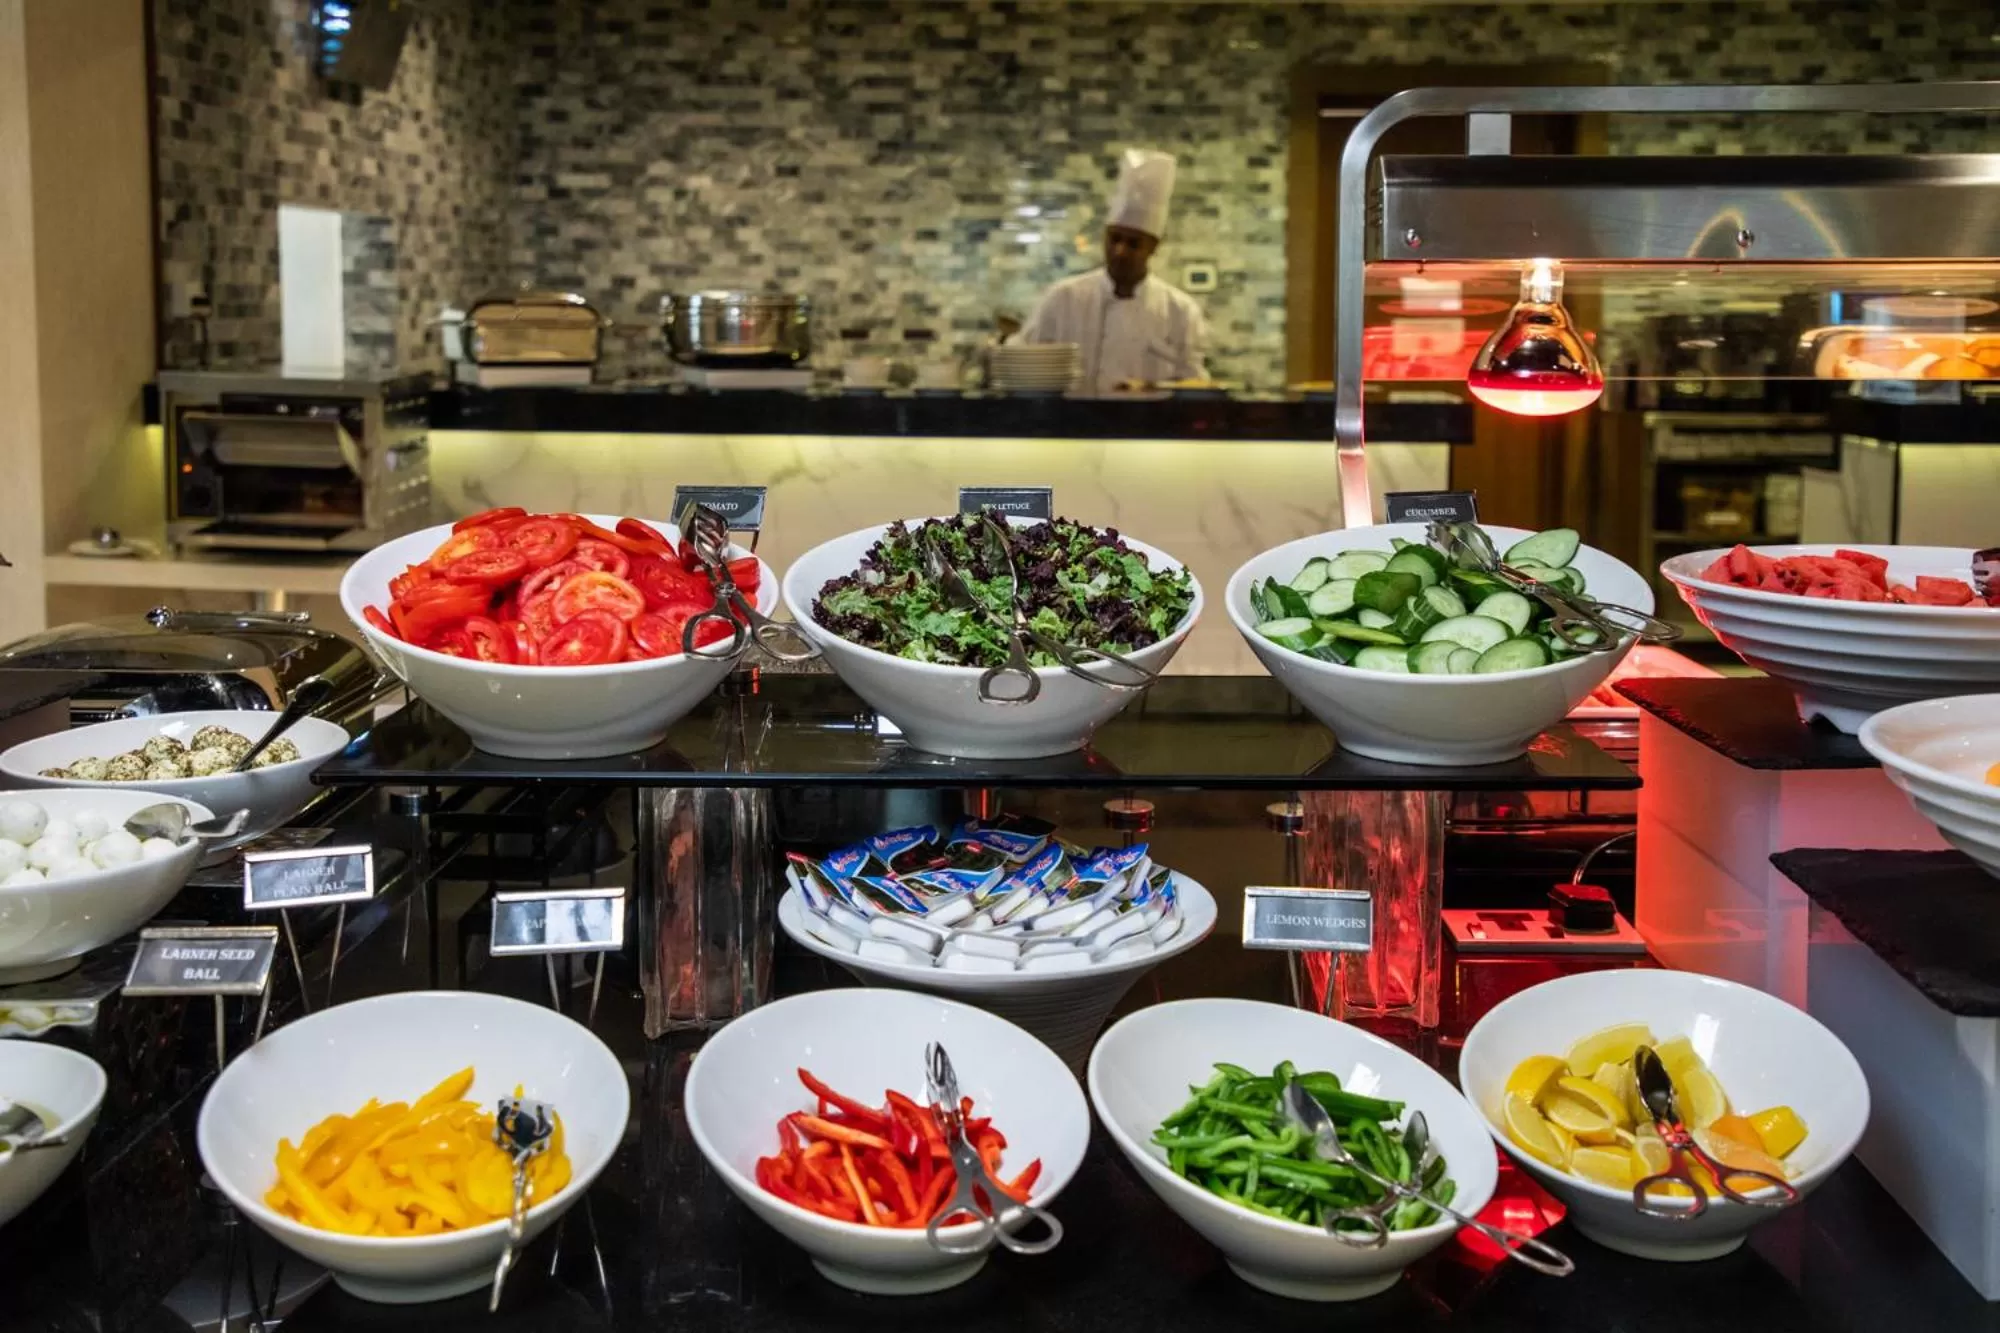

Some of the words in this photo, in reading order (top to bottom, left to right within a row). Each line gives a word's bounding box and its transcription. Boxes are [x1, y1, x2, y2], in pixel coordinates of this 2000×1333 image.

[1405, 507, 1457, 517] CUCUMBER
[314, 880, 348, 894] BALL
[1265, 914, 1310, 927] LEMON
[1314, 917, 1367, 929] WEDGES
[218, 949, 256, 960] SEED
[182, 967, 220, 980] BALL
